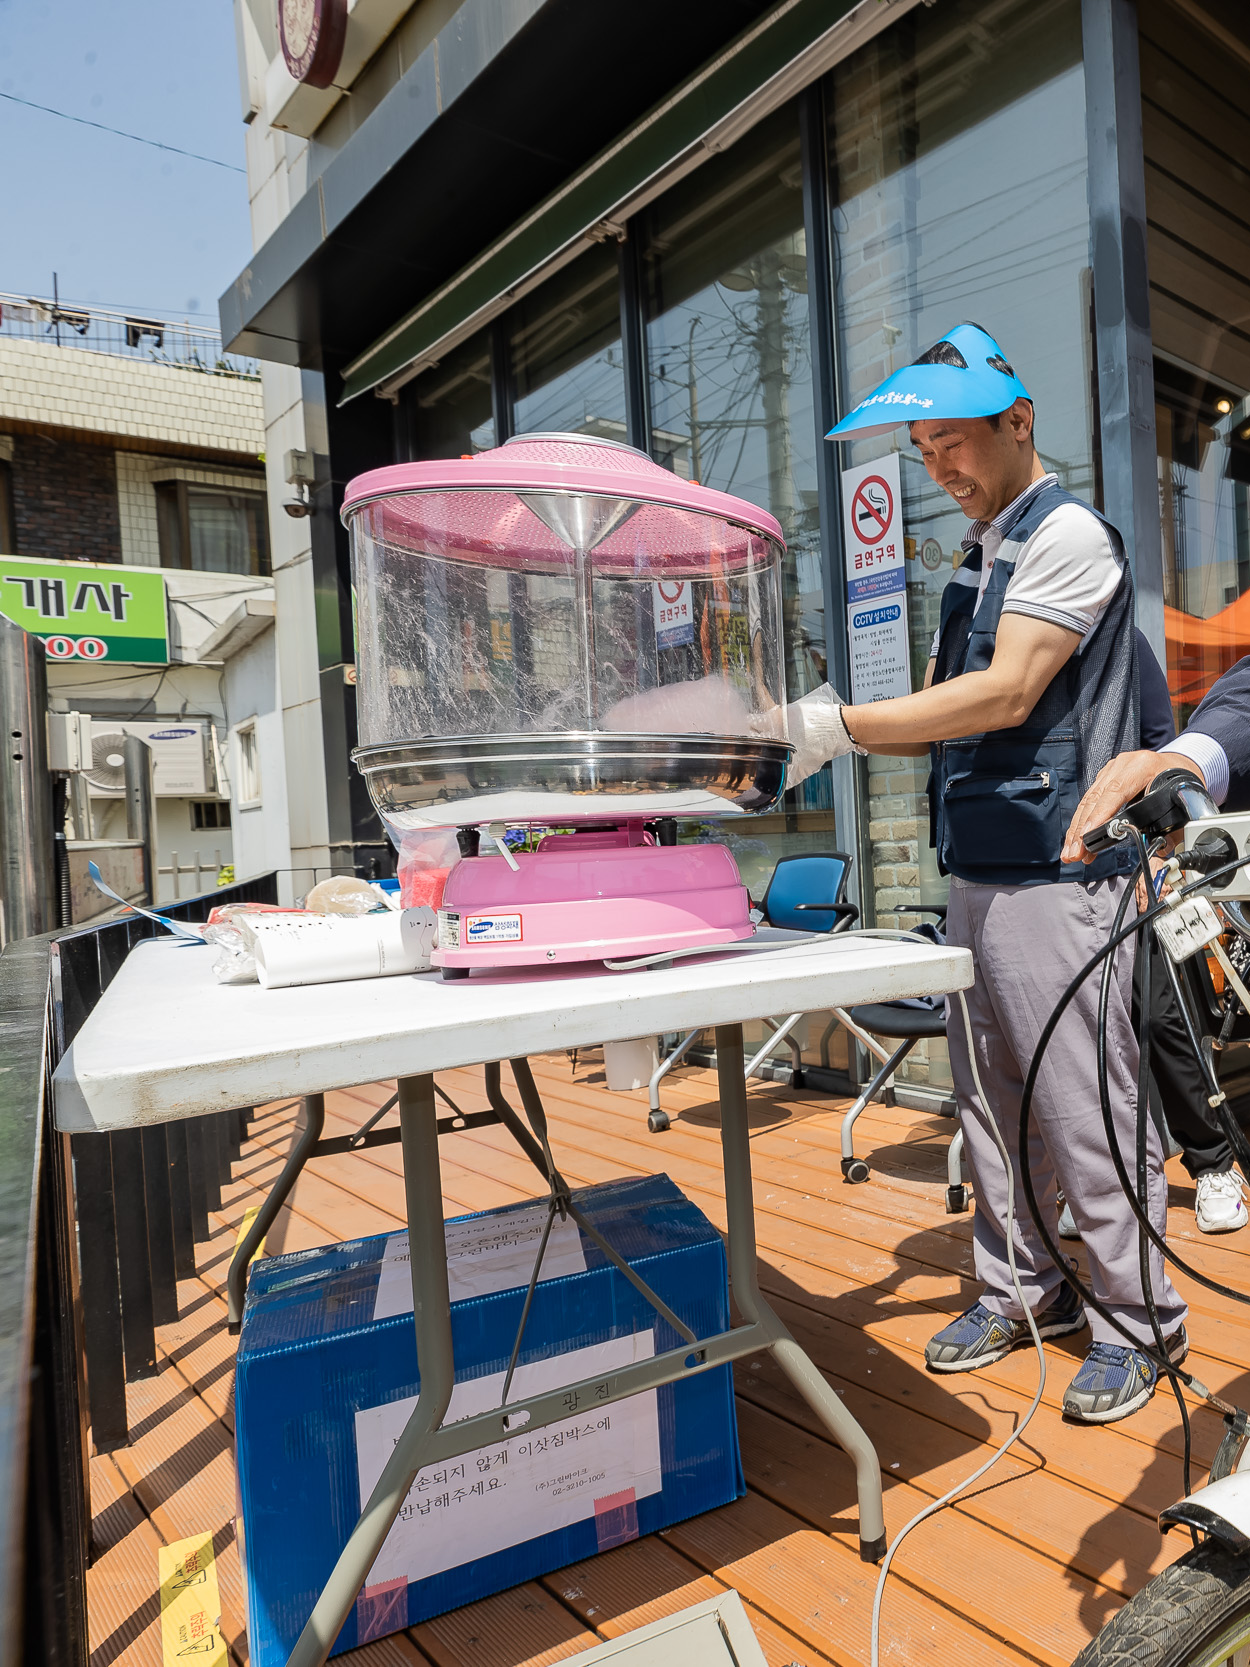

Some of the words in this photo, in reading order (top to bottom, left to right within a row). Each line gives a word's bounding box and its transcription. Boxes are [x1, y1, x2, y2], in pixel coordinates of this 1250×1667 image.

[855, 544, 895, 570] 금연구역
[3, 575, 132, 622] 개사
[660, 603, 687, 624] 금연구역
[855, 613, 873, 627] CCTV
[408, 1464, 465, 1496] 손되지
[477, 1450, 508, 1472] 않게
[519, 1417, 611, 1456] 이삿짐박스에
[535, 1468, 588, 1491] (주)그린바이크
[552, 1472, 606, 1496] 02-3210-1005
[399, 1478, 507, 1521] 반납해주세요.
